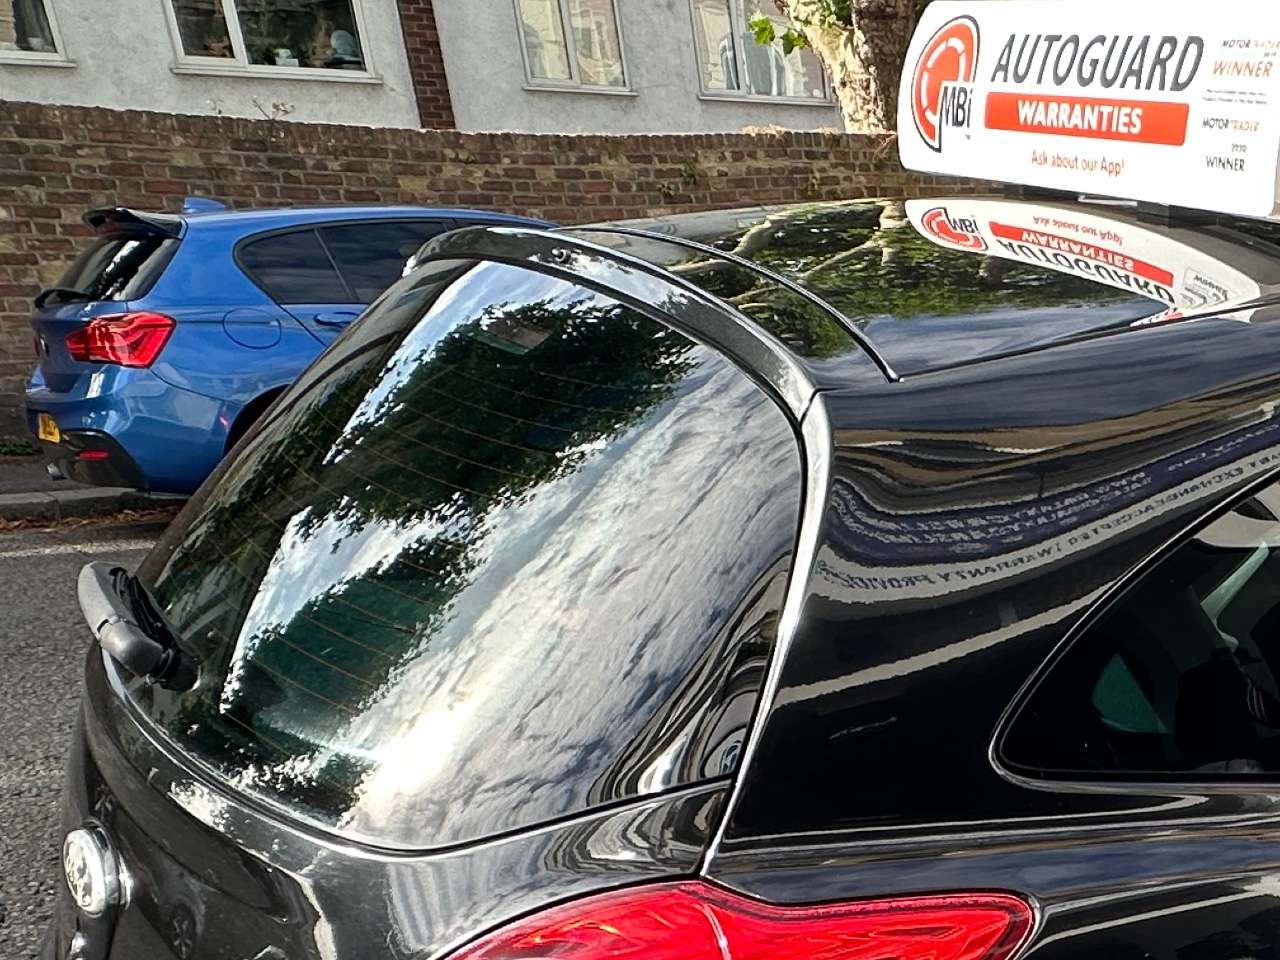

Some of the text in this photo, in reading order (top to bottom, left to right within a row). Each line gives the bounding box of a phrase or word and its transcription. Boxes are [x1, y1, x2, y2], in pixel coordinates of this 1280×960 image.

[990, 33, 1204, 92] AUTOGUARD
[1213, 60, 1273, 77] WINNER
[942, 85, 974, 128] MBi
[1017, 99, 1144, 135] WARRANTIES
[1202, 117, 1230, 129] MOTOR
[1032, 149, 1125, 177] Ask about our App!
[1205, 155, 1246, 172] WINNER
